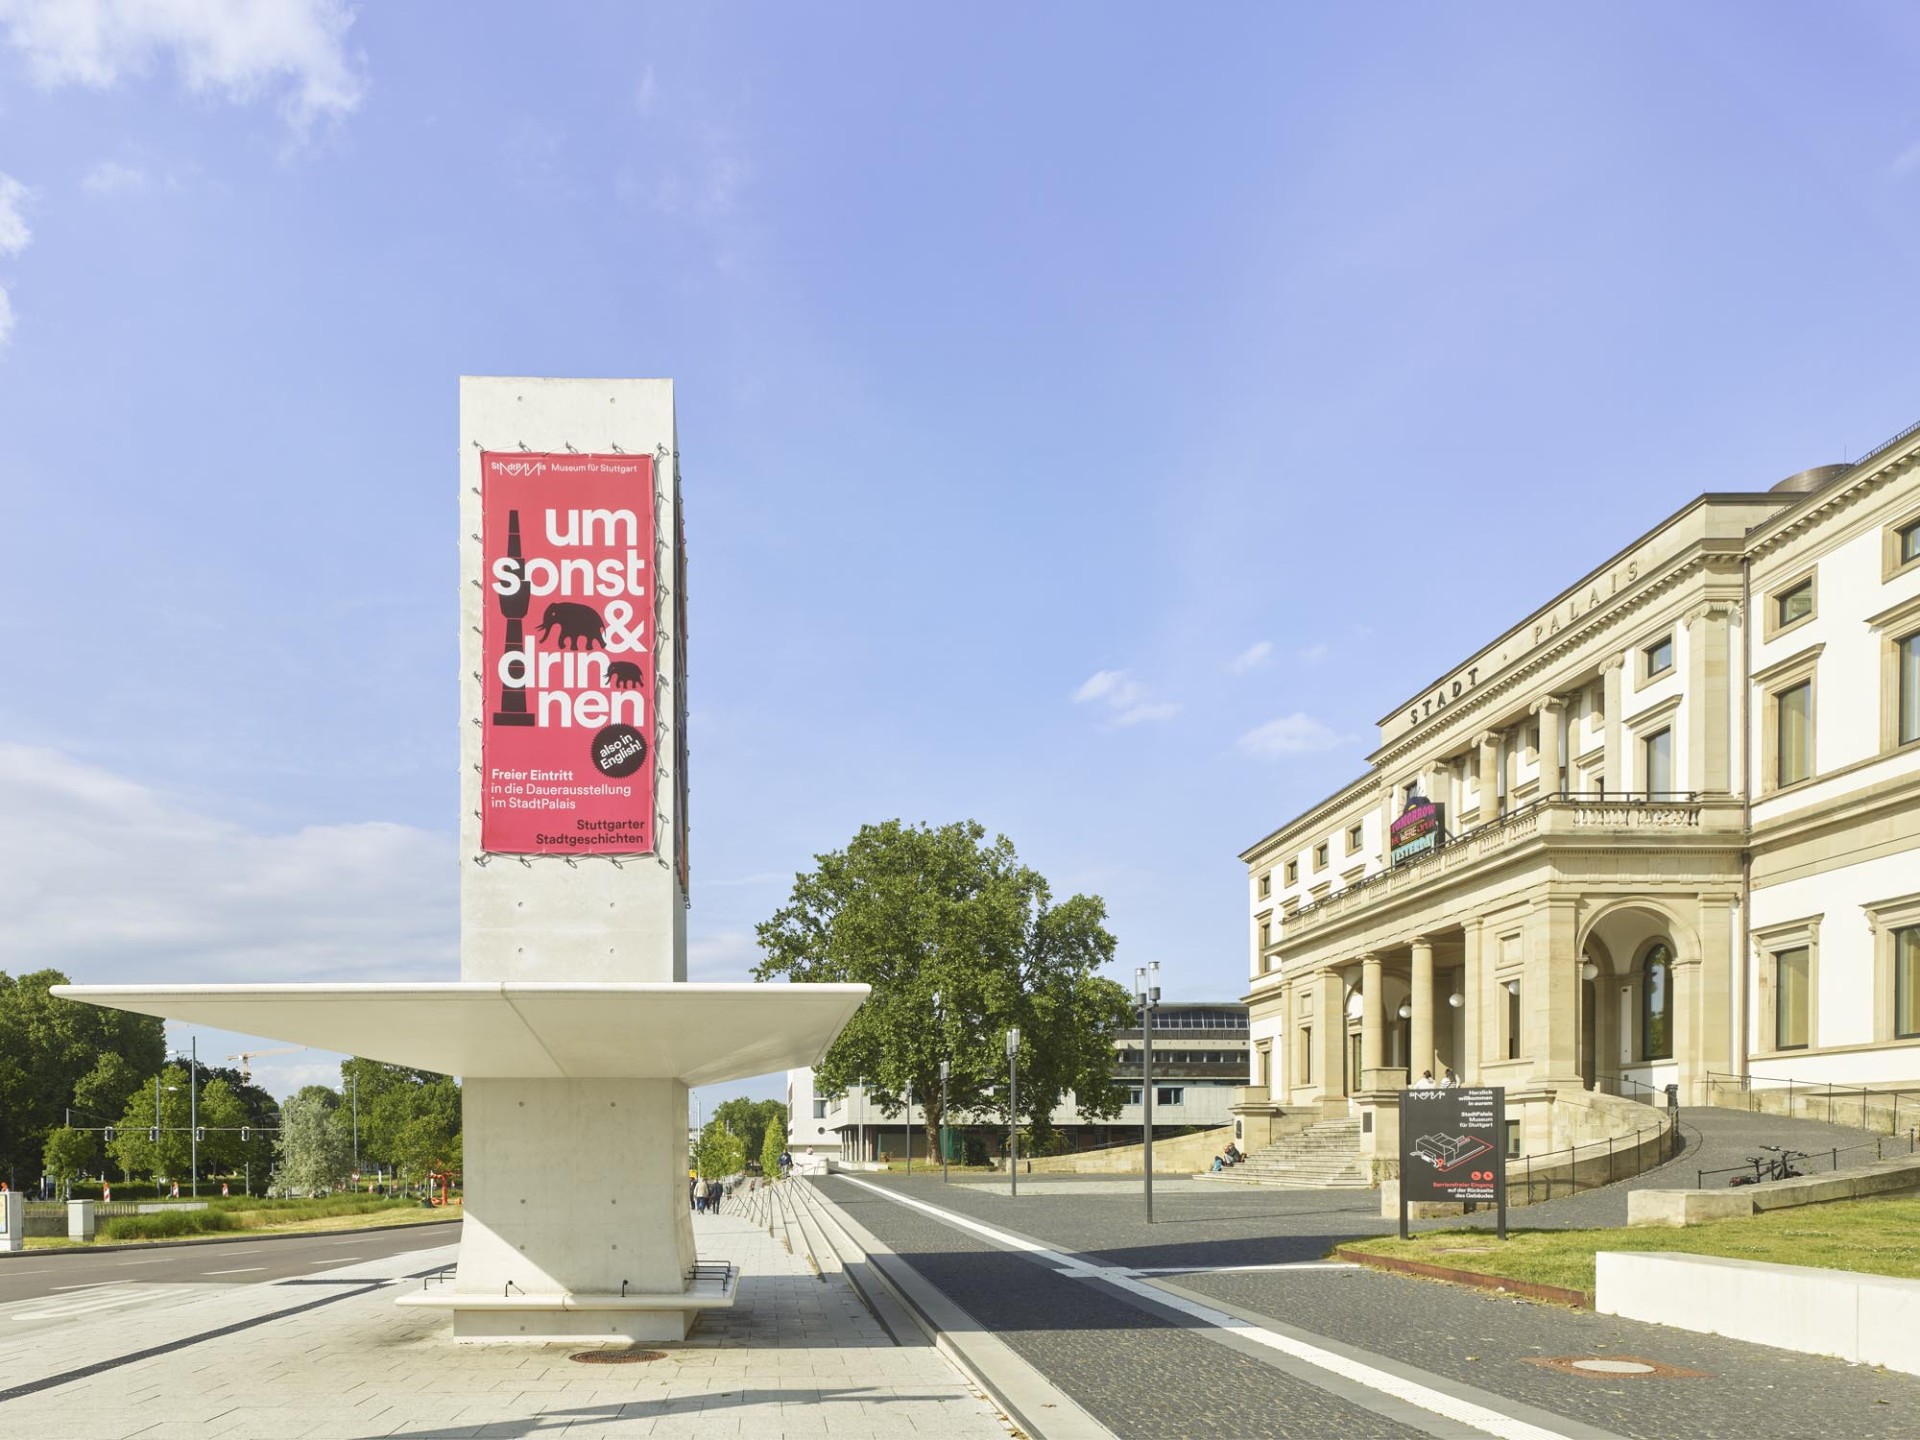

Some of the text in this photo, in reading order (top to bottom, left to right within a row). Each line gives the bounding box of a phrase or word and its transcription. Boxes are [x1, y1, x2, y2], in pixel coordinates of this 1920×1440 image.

[551, 462, 586, 472] Museum
[587, 462, 599, 472] für
[600, 463, 637, 474] Stuttgart
[545, 508, 637, 547] um
[491, 549, 645, 596] sonst
[602, 599, 648, 653] &
[1409, 560, 1639, 725] STADT PALAIS
[498, 635, 611, 688] drin
[538, 690, 644, 728] nen
[599, 733, 633, 758] also in
[600, 741, 643, 770] English!
[492, 768, 573, 781] Freier Eintritt
[491, 783, 631, 796] in die Dauerausstellung
[491, 798, 576, 809] im StadtPalais
[577, 819, 645, 832] Stuttgarter
[536, 833, 643, 847] Stadtgeschichten
